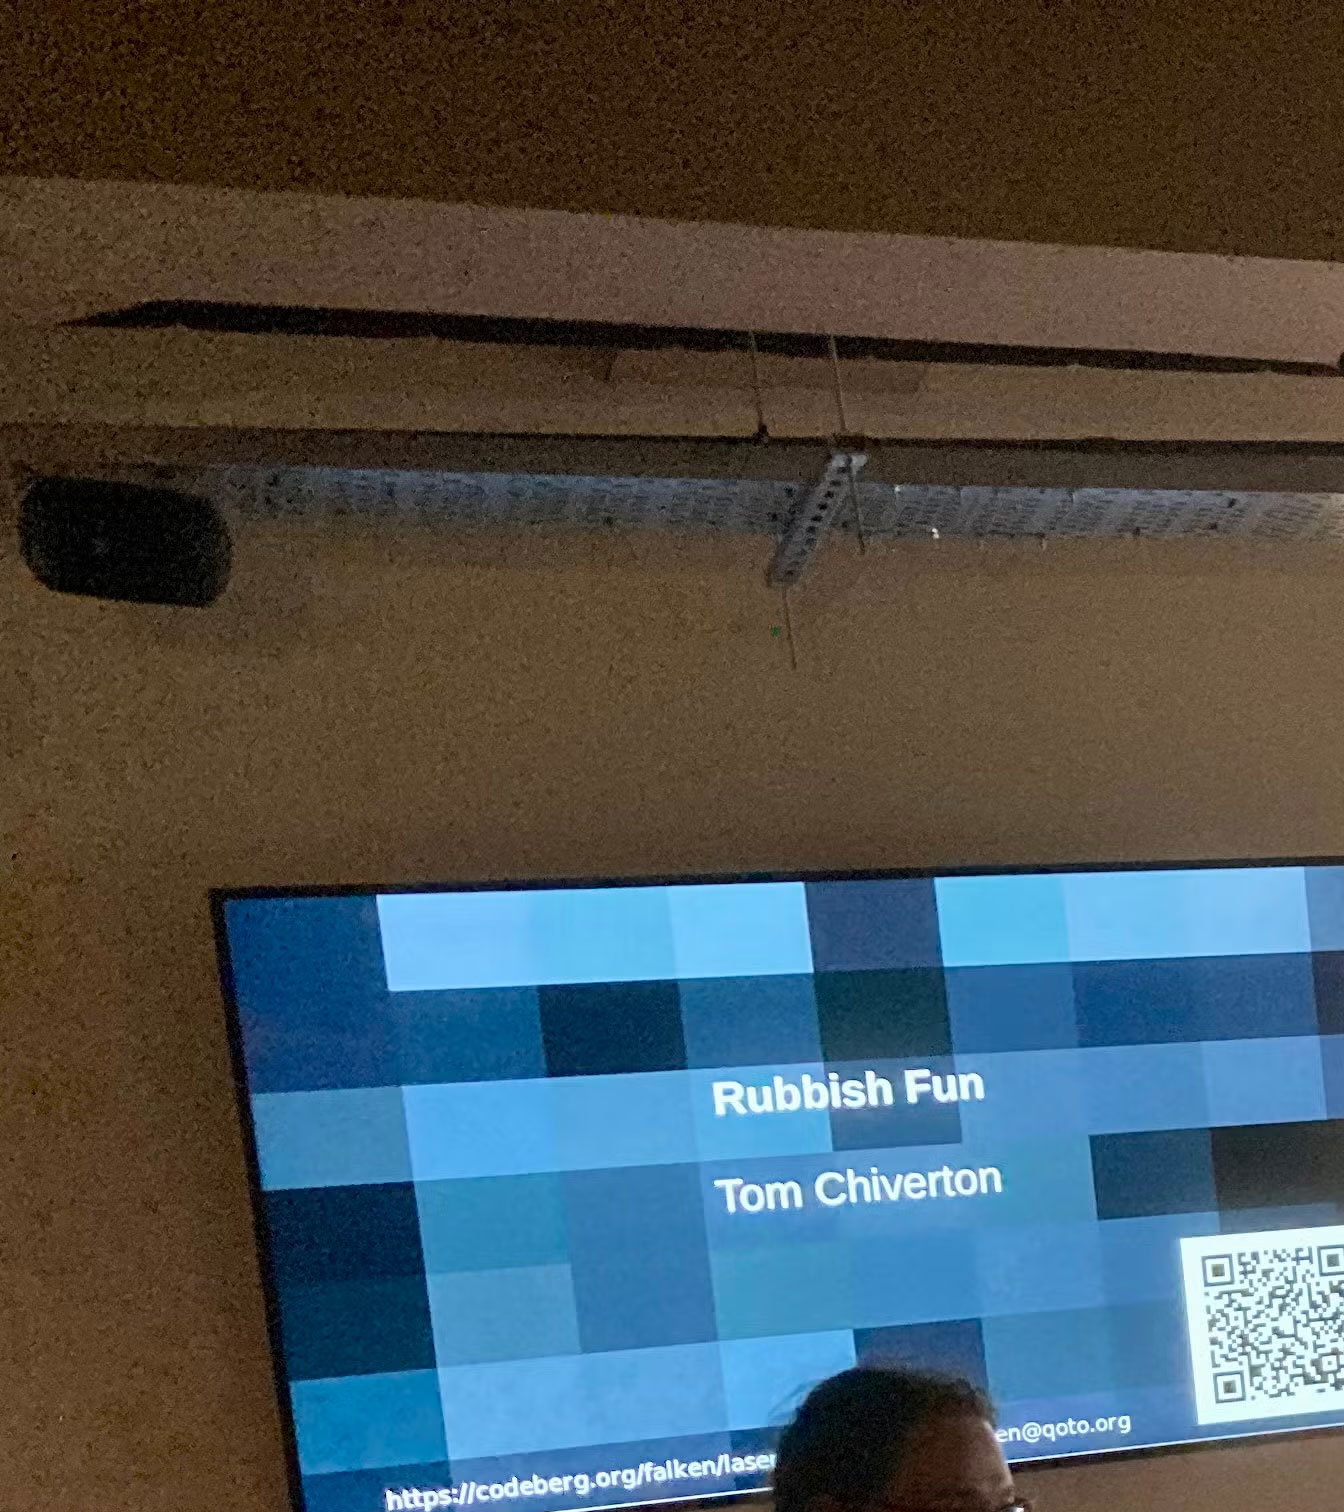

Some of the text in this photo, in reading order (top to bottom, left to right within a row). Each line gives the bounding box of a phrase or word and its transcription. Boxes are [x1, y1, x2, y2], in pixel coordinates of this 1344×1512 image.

[711, 1068, 986, 1117] Rubbish Fun
[713, 1165, 1003, 1214] Tom Chiverton
